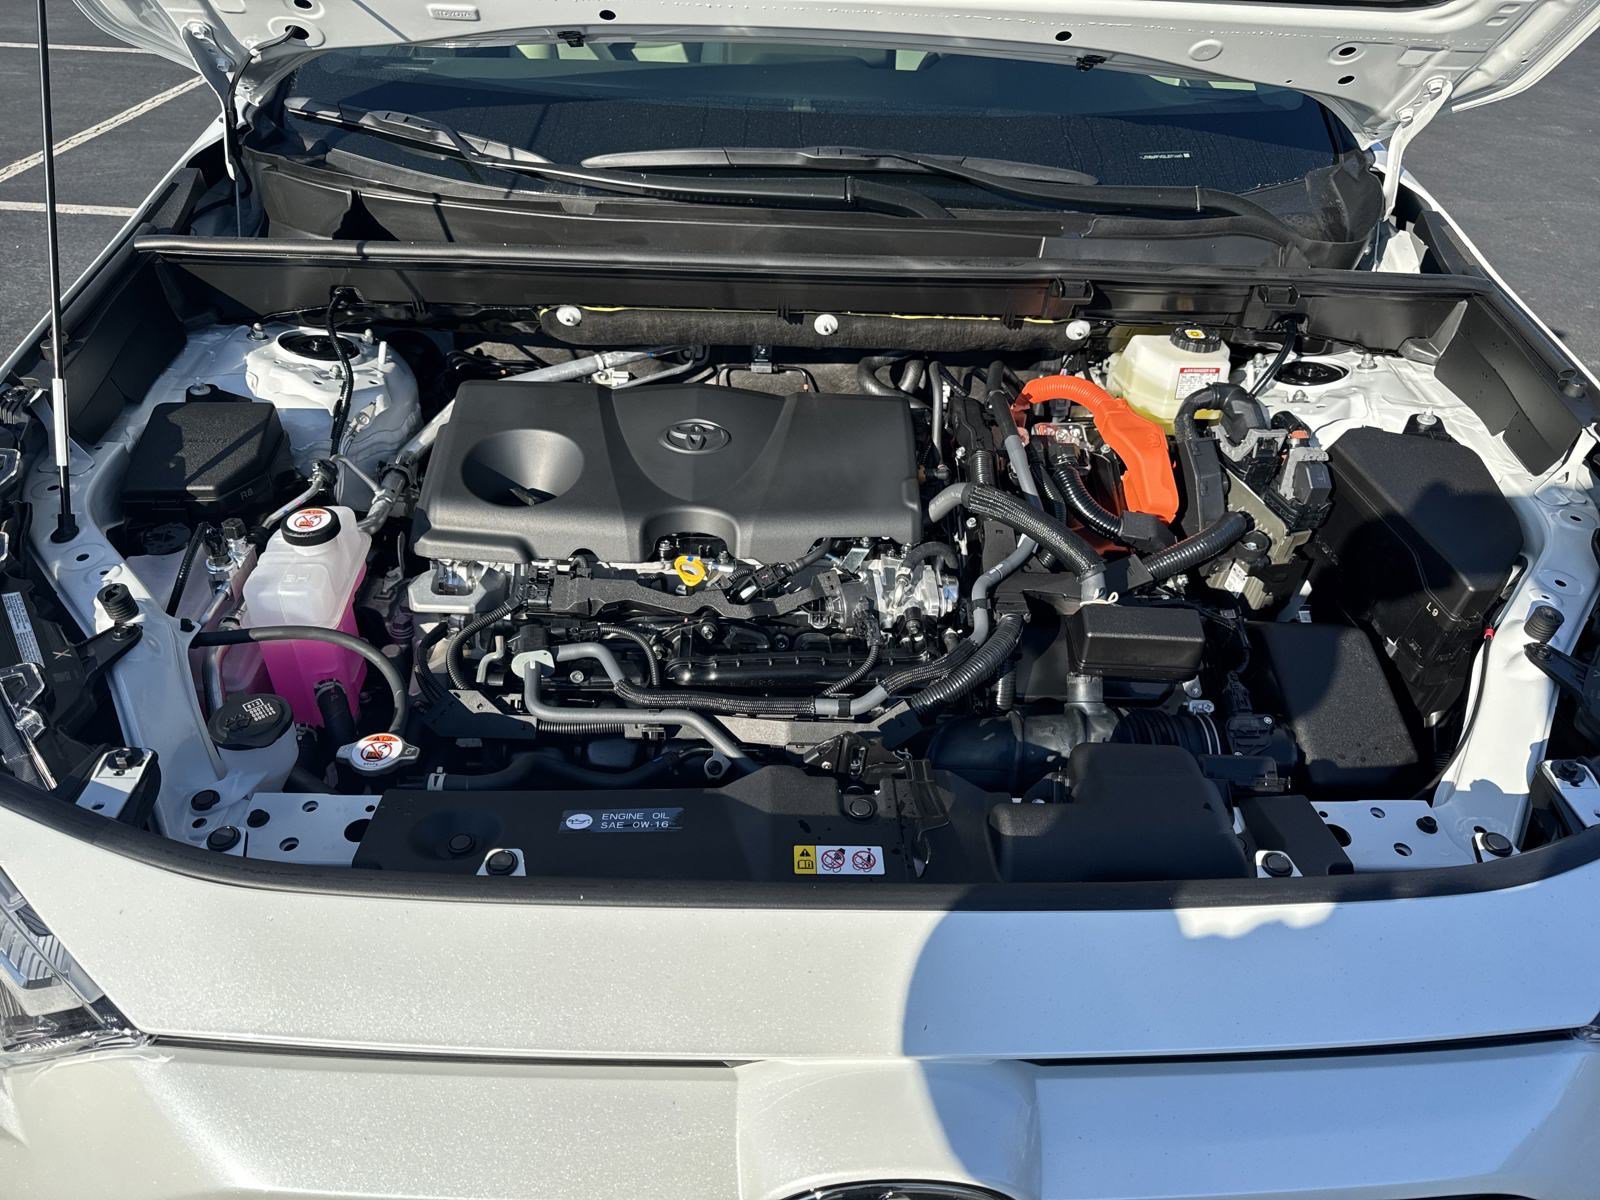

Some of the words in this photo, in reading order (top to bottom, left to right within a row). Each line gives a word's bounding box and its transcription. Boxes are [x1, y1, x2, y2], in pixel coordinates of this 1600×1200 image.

[601, 812, 645, 820] ENGINE
[652, 812, 670, 820] OIL
[600, 821, 625, 829] SAE
